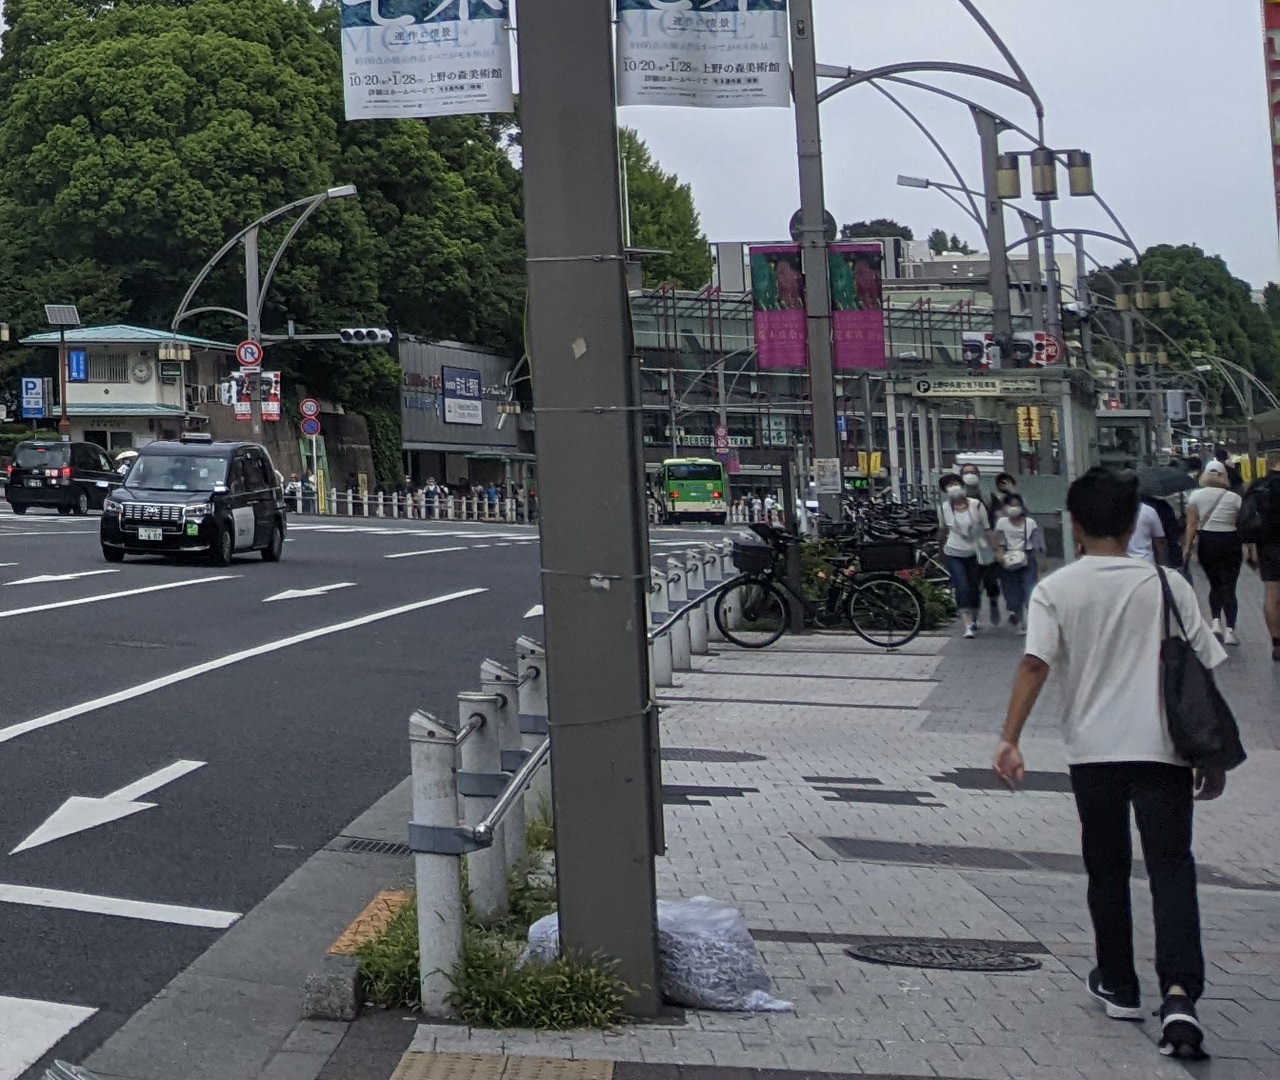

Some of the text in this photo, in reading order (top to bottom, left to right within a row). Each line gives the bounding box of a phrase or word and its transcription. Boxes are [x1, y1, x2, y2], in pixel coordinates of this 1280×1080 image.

[394, 28, 452, 41] 連作の情景
[703, 62, 780, 74] 上野の森美術館
[428, 68, 503, 84] 上野の森美術館
[25, 380, 37, 396] P
